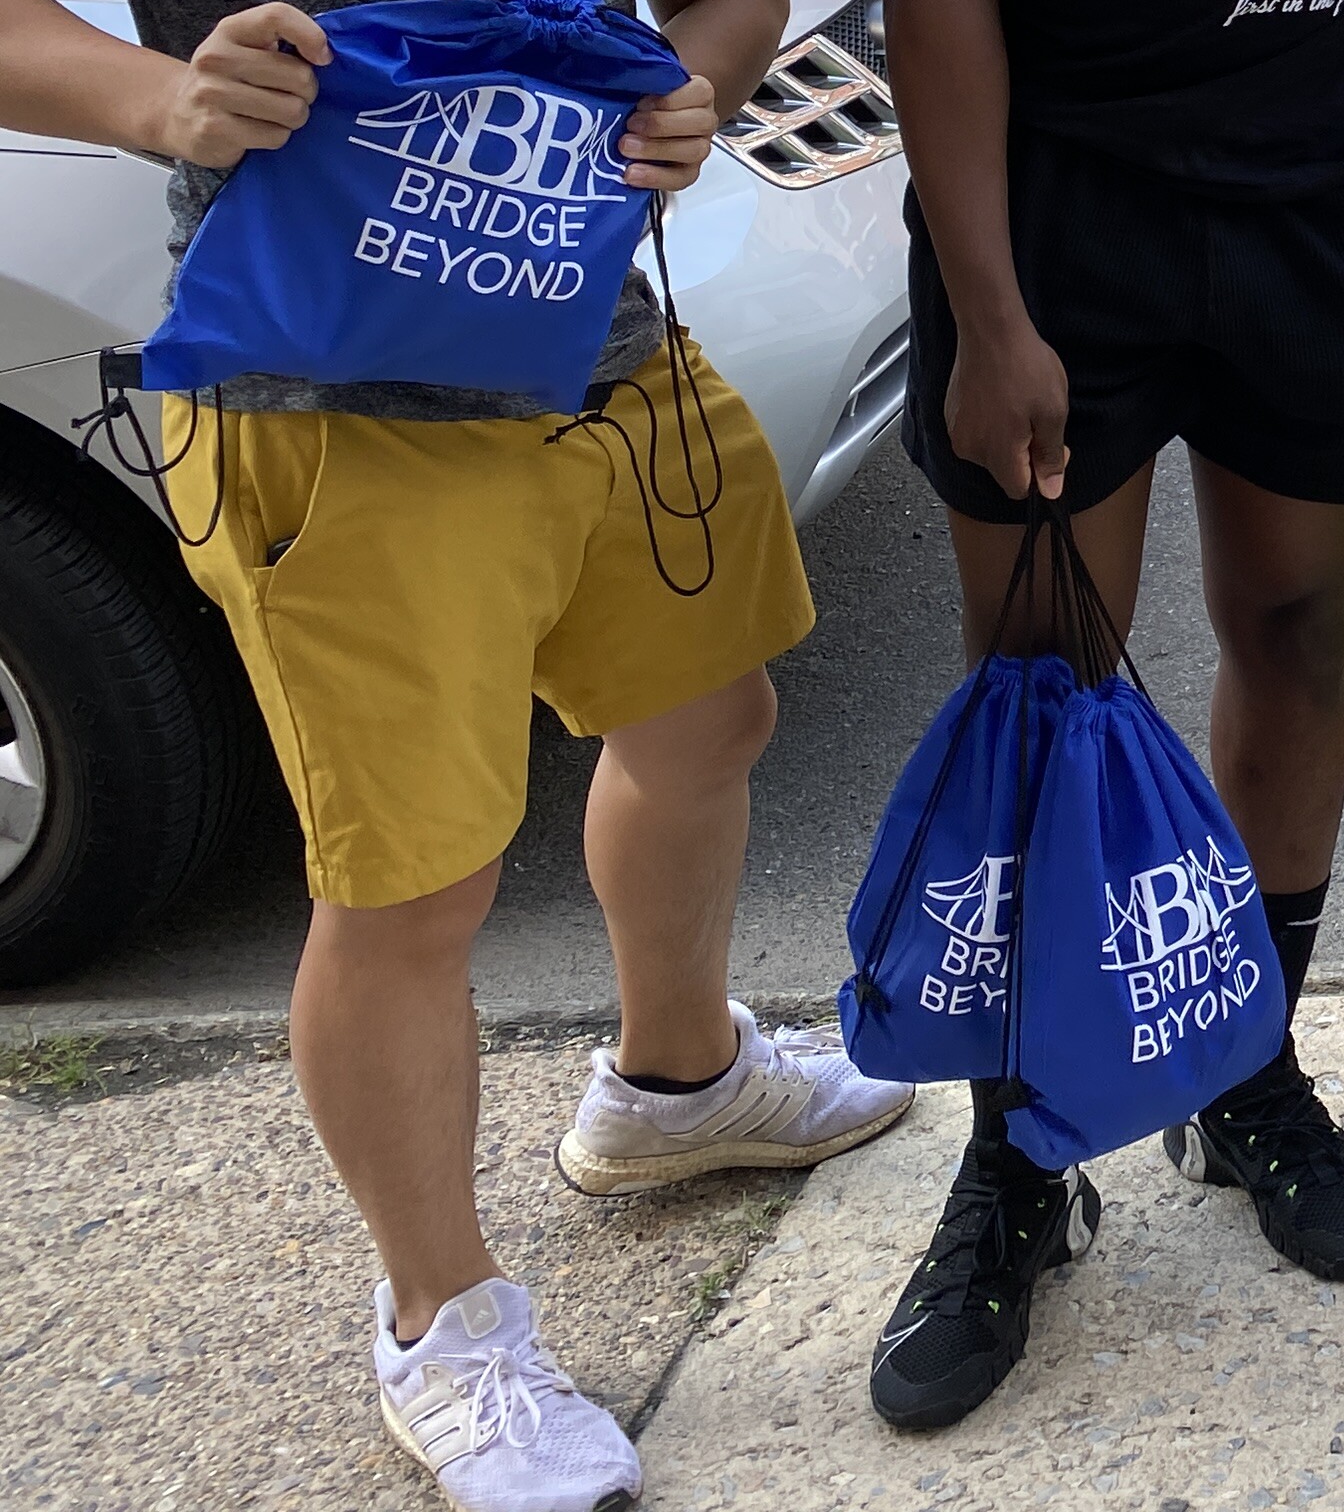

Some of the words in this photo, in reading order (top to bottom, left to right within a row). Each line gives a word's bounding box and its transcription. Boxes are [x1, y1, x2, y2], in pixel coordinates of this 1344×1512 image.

[391, 166, 587, 248] BRIDGE
[354, 217, 584, 301] BEYOND
[1127, 917, 1240, 1013] BRIDGE
[1132, 958, 1261, 1064] BEYOND
